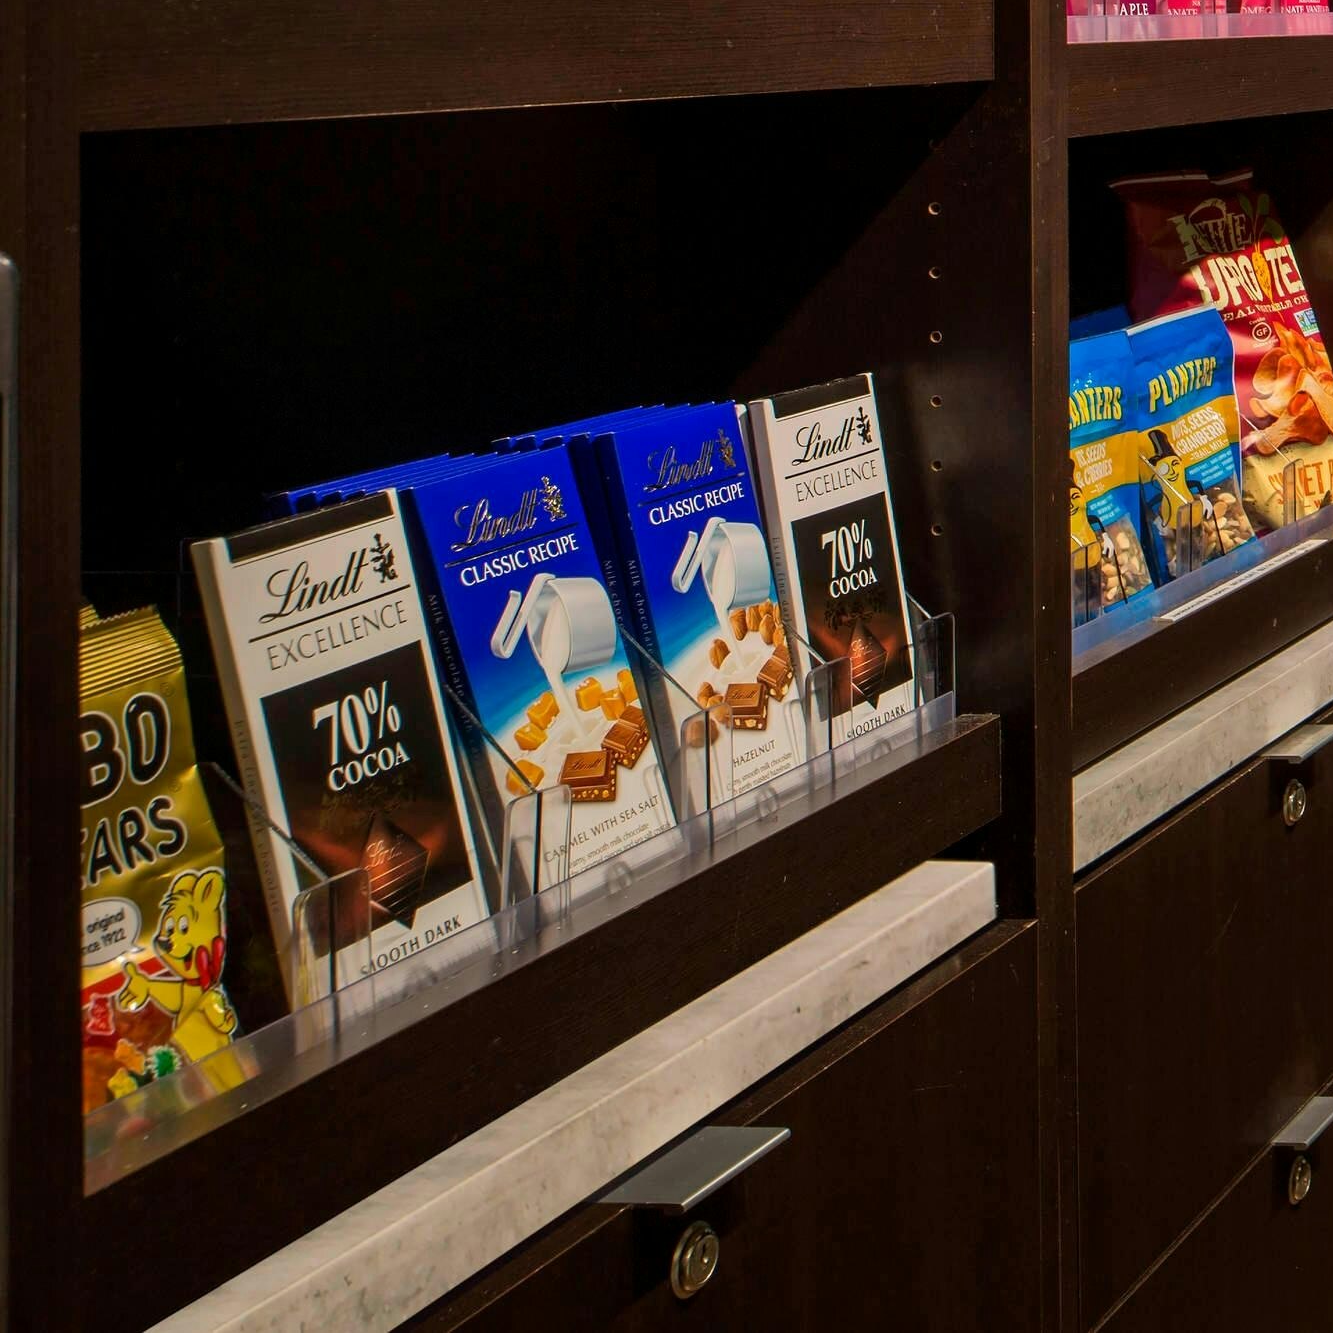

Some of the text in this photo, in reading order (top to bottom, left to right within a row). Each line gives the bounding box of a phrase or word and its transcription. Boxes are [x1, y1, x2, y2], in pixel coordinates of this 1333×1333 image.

[1256, 327, 1269, 337] GF
[1070, 386, 1123, 430] ANTERS
[792, 416, 857, 467] Lindt
[644, 440, 715, 492] Lindt
[795, 459, 879, 503] EXCELLENCE
[450, 489, 538, 554] Lindt
[649, 480, 746, 526] CLASSIC RECIPE
[460, 532, 580, 588] CLASSIC RECIPE
[820, 518, 874, 580] 70%
[258, 549, 370, 625] Lindt
[627, 558, 640, 587] Milk
[829, 565, 878, 599] COCOA
[428, 592, 442, 624] Milk
[266, 600, 409, 672] EXCELLENCE
[312, 679, 400, 765] 70%
[883, 703, 907, 724] DARK
[326, 741, 410, 791] COCOA
[732, 739, 776, 769] HAZELNUT
[590, 814, 618, 838] WITH
[619, 806, 639, 824] SEA
[638, 794, 661, 815] SALT
[82, 795, 188, 890] ARS
[87, 908, 125, 934] original
[424, 914, 462, 946] DARK
